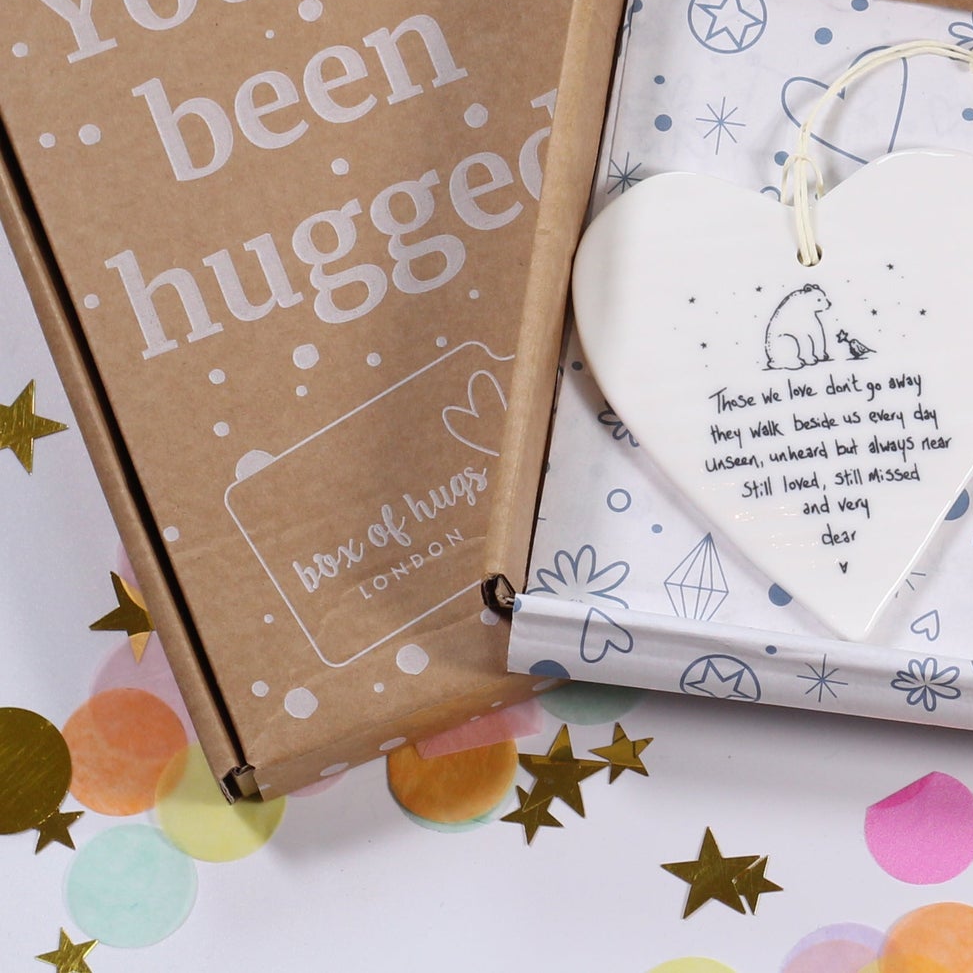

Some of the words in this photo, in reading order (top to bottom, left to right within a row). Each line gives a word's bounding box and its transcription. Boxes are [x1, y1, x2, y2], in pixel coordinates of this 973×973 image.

[132, 14, 468, 182] been
[709, 386, 756, 415] Those
[787, 378, 818, 400] love
[867, 381, 882, 401] go
[888, 374, 921, 396] away
[710, 425, 742, 448] they
[749, 418, 784, 438] walk
[794, 408, 838, 432] beside
[843, 413, 861, 424] us
[870, 406, 905, 431] every
[913, 405, 939, 430] day
[769, 441, 828, 463] unheard
[836, 440, 858, 455] but
[869, 436, 915, 462] always
[921, 435, 952, 450] near
[784, 472, 826, 493] loved,
[802, 498, 830, 514] and
[838, 497, 870, 518] very
[292, 539, 363, 593] box
[368, 505, 411, 547] of
[403, 466, 487, 521] hugs
[822, 523, 857, 547] dear
[359, 529, 464, 599] LONDON
